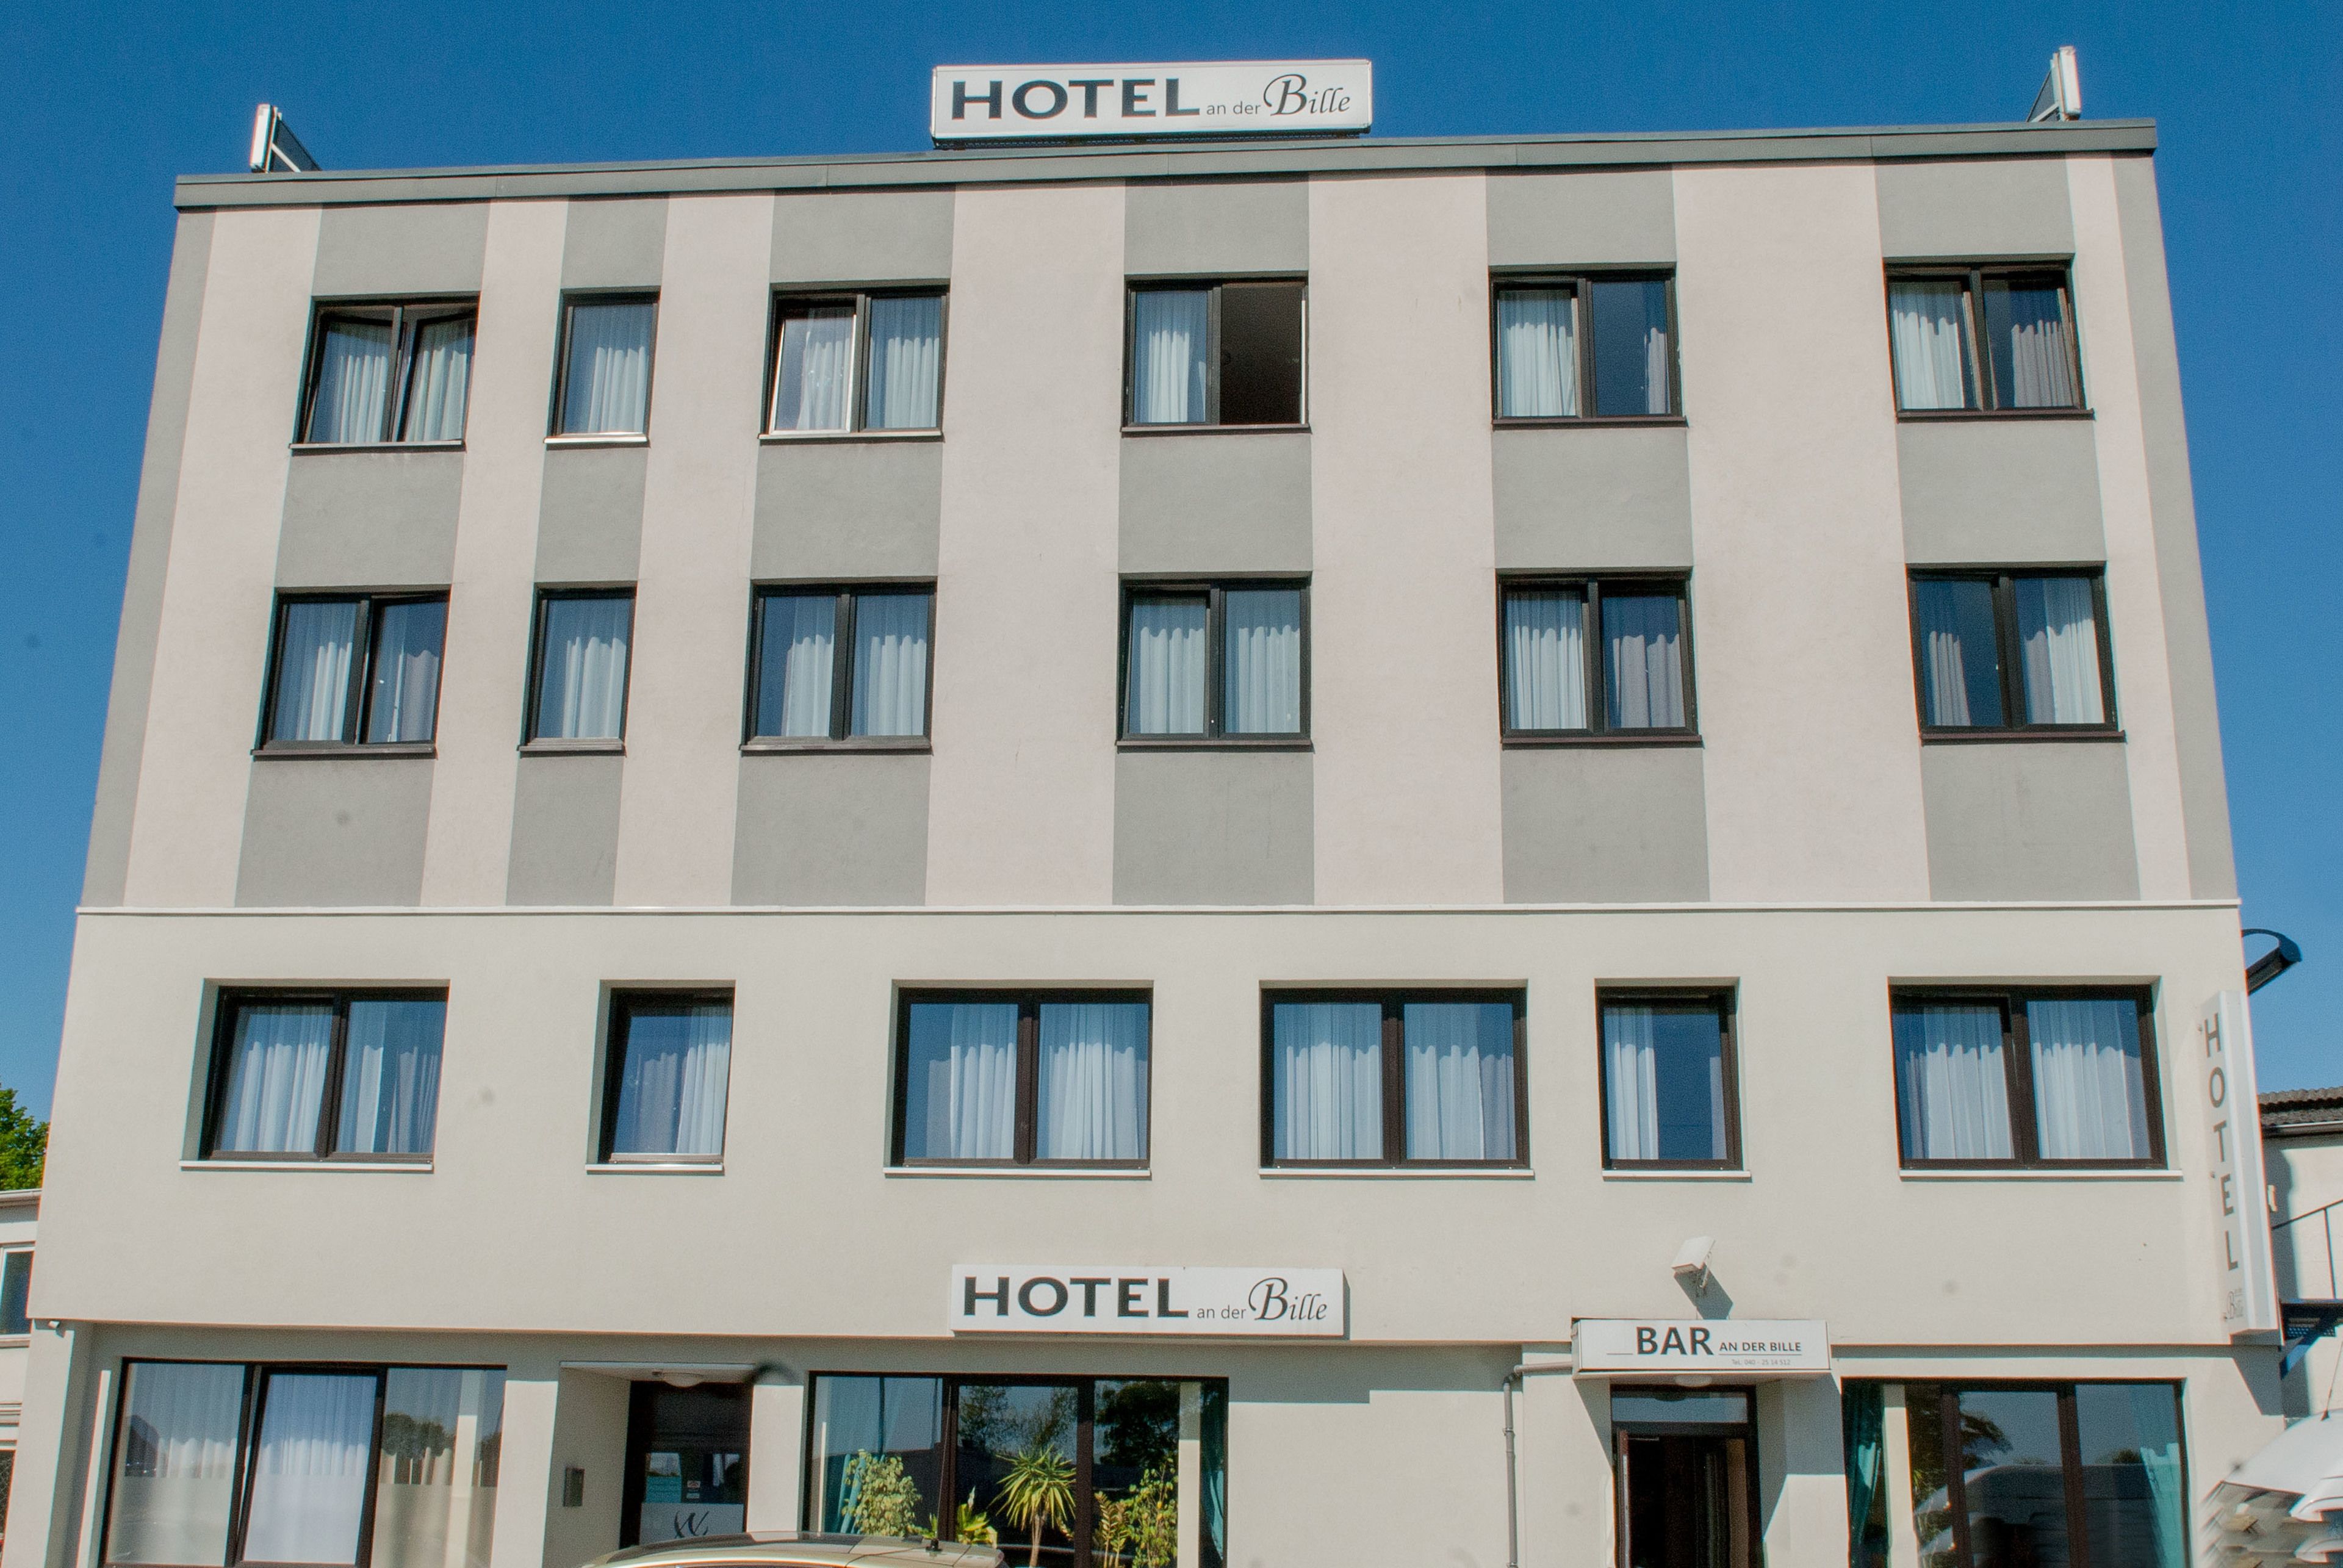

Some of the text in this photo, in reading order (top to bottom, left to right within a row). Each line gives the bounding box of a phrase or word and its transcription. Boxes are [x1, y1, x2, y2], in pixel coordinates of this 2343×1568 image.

[951, 73, 1350, 120] HOTEL an der Bille
[2204, 1012, 2239, 1271] HOTEL
[963, 1276, 1328, 1321] HOTEL an der Bille
[1636, 1326, 1802, 1356] BAR AN DER BILLE
